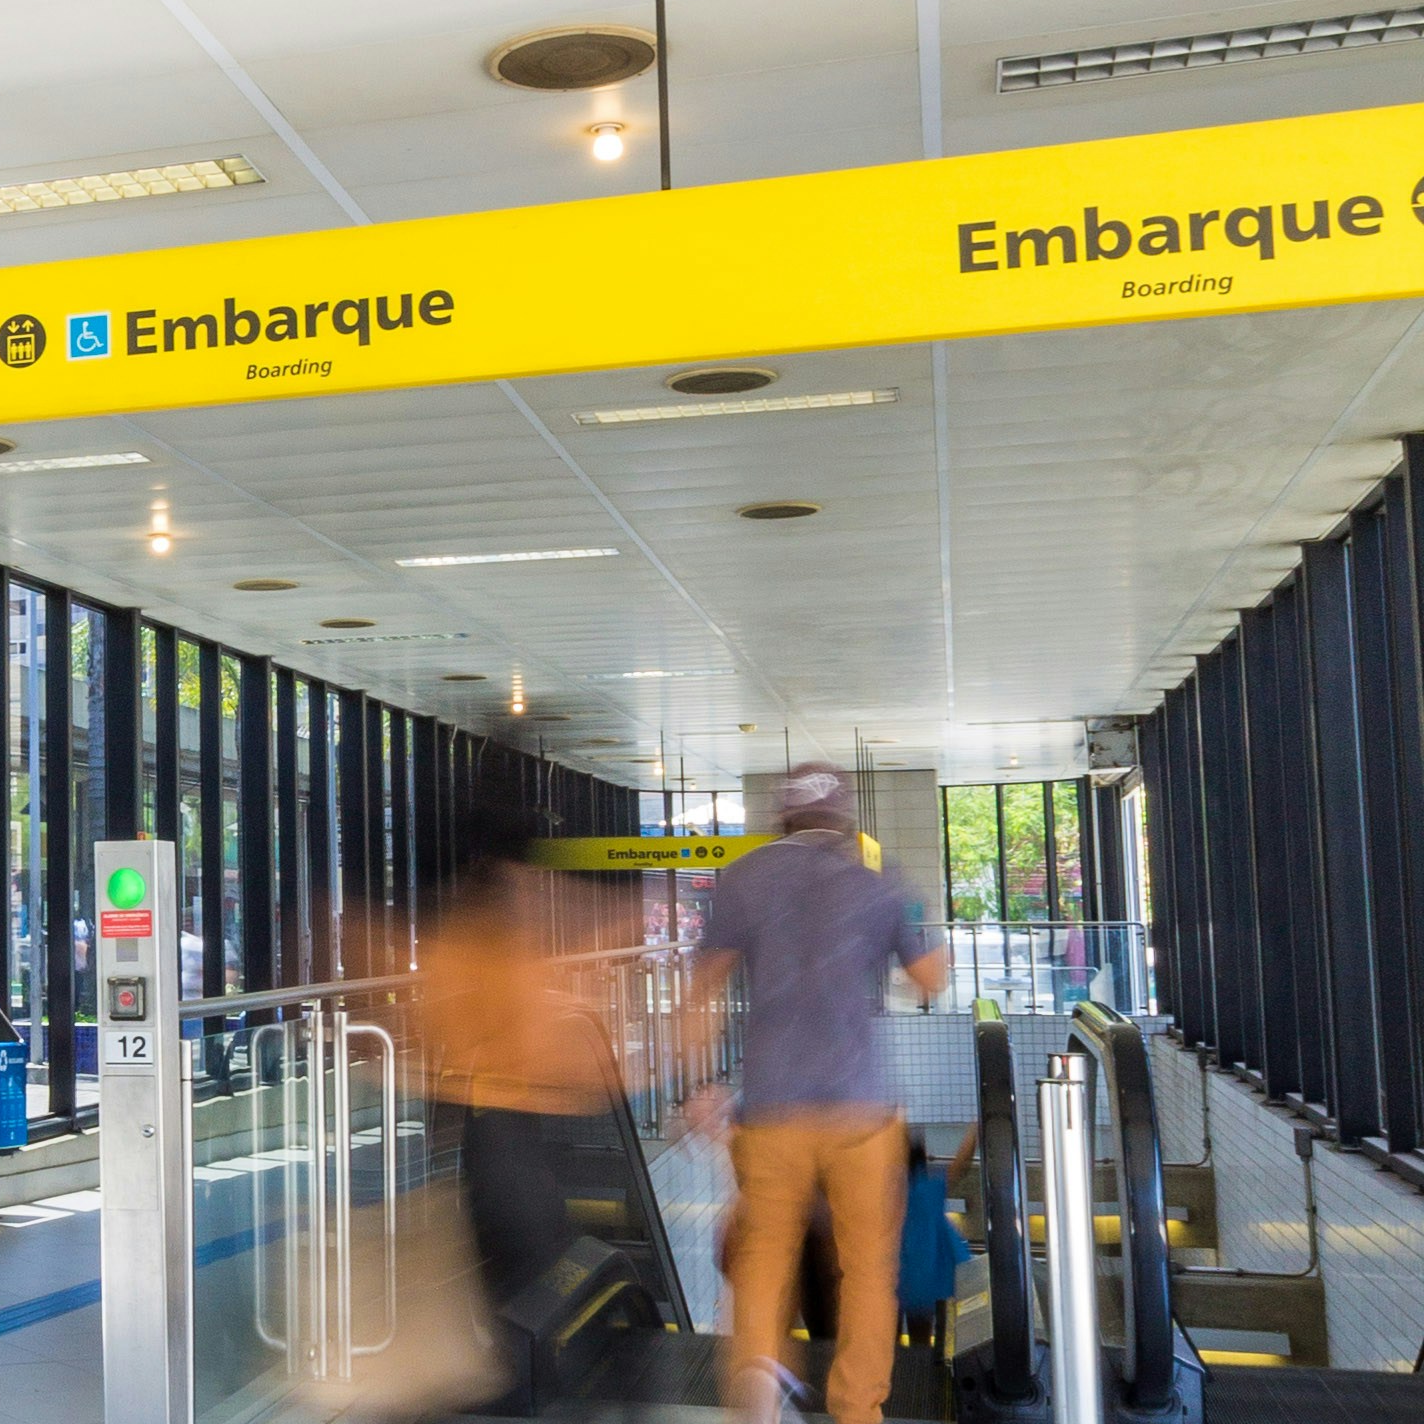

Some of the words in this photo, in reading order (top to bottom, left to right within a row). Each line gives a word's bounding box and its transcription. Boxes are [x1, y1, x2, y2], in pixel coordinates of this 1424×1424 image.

[957, 194, 1385, 274] Embarque
[1120, 273, 1234, 299] Boarding
[125, 287, 456, 357] Embarque
[244, 355, 333, 381] Boarding
[607, 848, 679, 862] Embarque
[117, 1035, 147, 1059] 12
